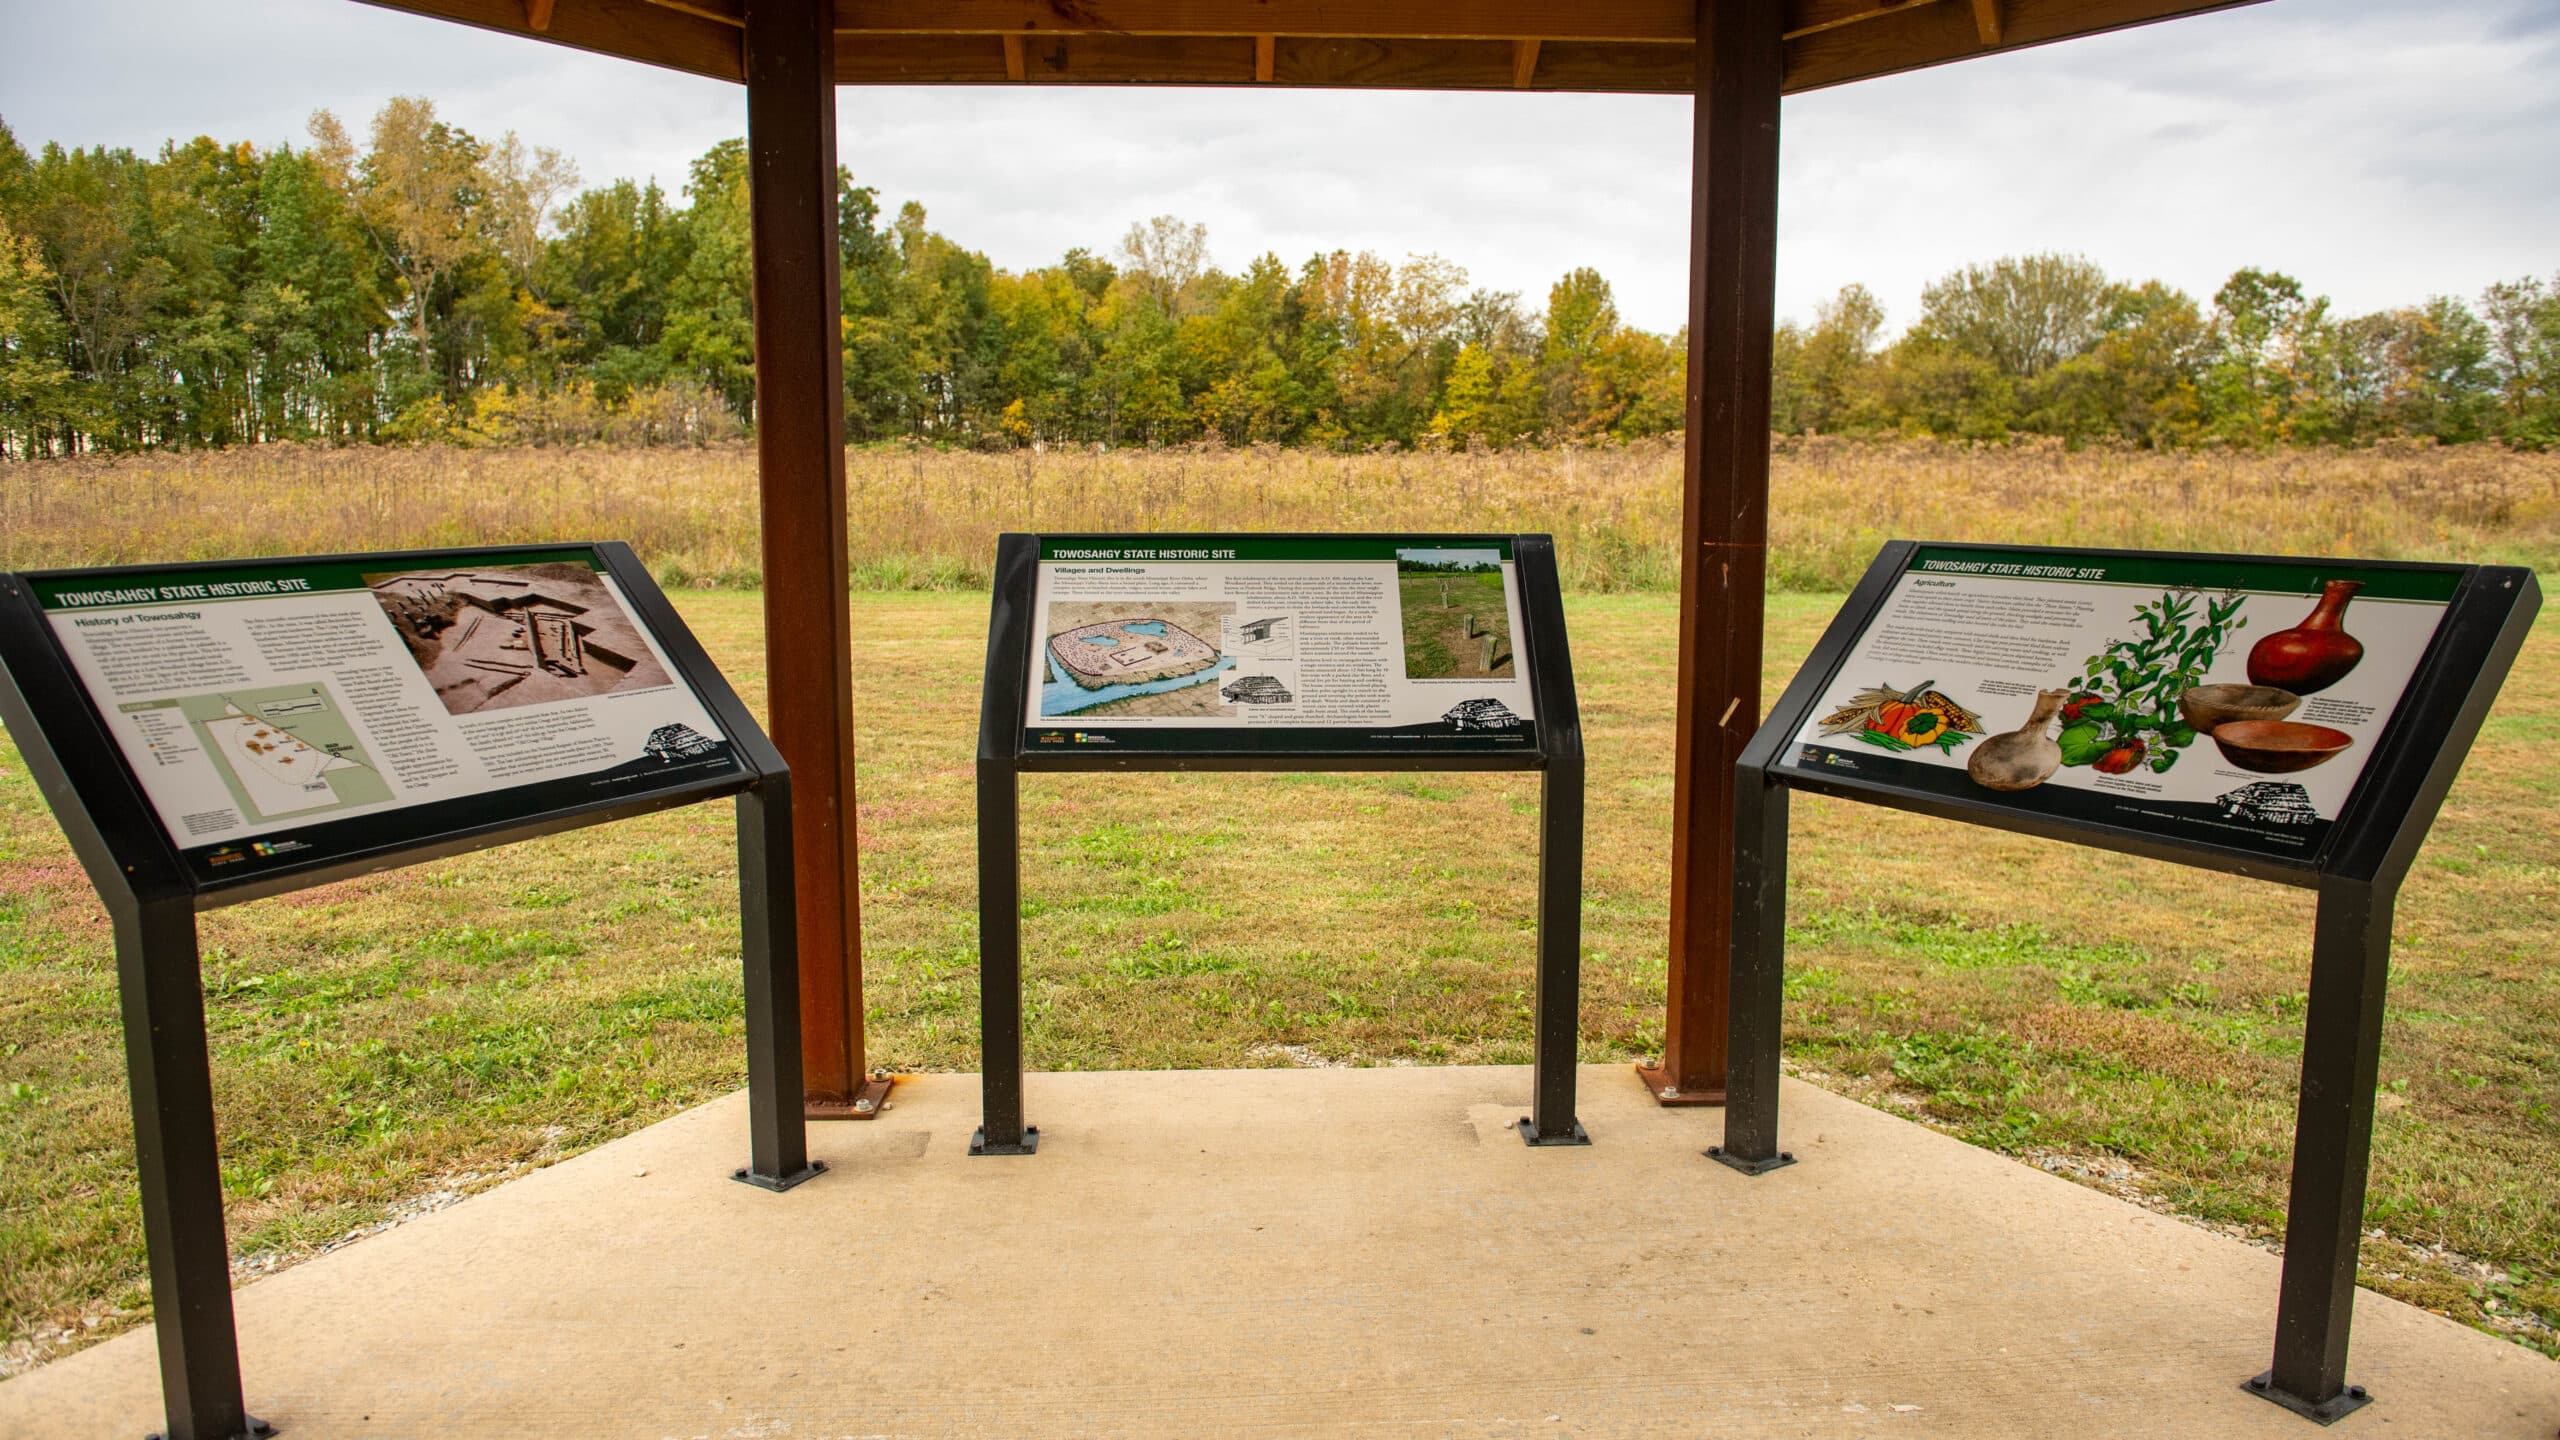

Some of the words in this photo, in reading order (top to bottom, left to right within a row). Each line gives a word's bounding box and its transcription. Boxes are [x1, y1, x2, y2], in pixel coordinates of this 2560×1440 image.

[1053, 549, 1121, 559] TOWOSAHGY
[1123, 549, 1157, 559] STATE
[1158, 549, 1209, 559] HISTORIC
[1211, 549, 1236, 559] SITE
[1105, 567, 1146, 575] Dwellings
[1922, 560, 1988, 573] TOWOSAHGY
[1987, 564, 2022, 575] STATE
[2022, 565, 2076, 578] HISTORIC
[2076, 568, 2106, 580] SITE
[1913, 578, 1956, 588] Agriculture
[55, 587, 157, 607] TOWOSAHGY
[160, 584, 206, 599] STATE
[207, 580, 275, 596] HISTORIC
[277, 578, 311, 592] SITE
[74, 616, 119, 627] History
[122, 614, 134, 624] of
[135, 611, 202, 623] Towosahgy
